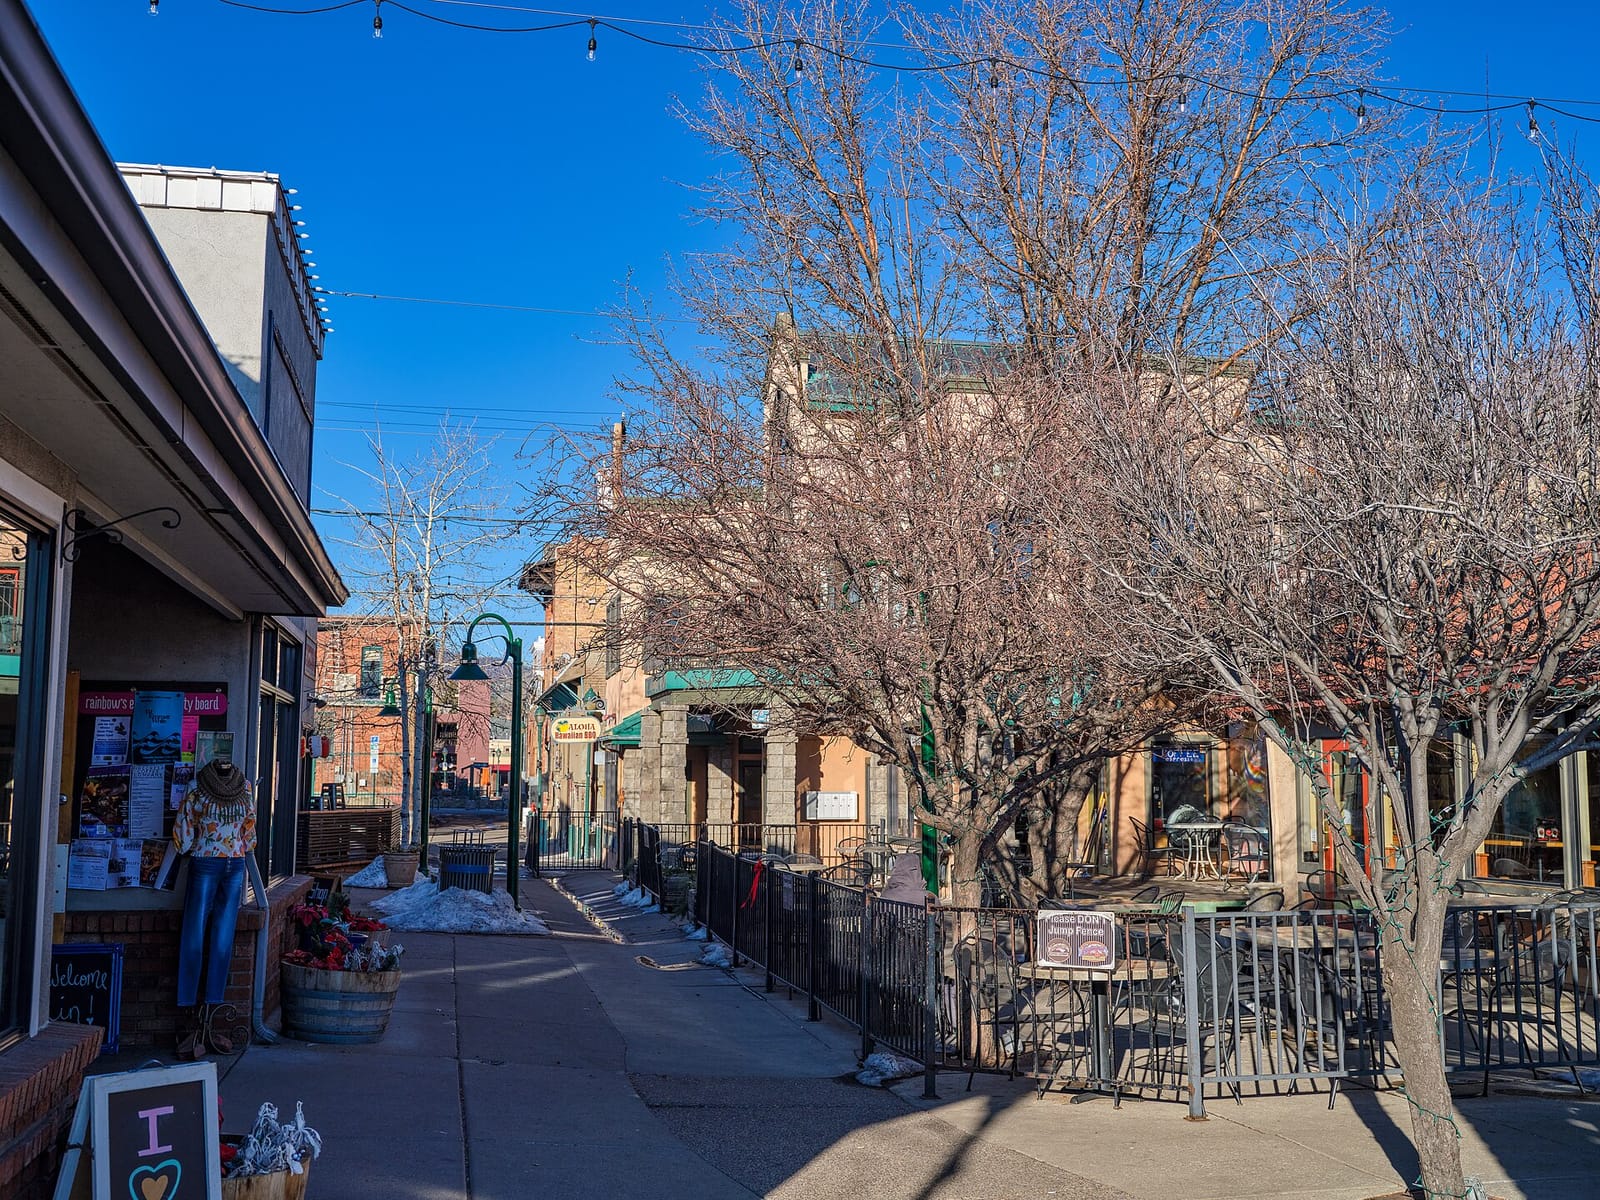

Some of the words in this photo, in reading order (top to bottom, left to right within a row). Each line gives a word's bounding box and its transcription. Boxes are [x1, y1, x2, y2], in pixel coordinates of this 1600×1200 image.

[85, 696, 127, 710] rainbow's
[195, 697, 220, 711] board
[569, 723, 595, 731] ALOHA
[1048, 925, 1074, 937] Jump
[1076, 926, 1105, 936] Fence
[137, 1105, 175, 1157] I
